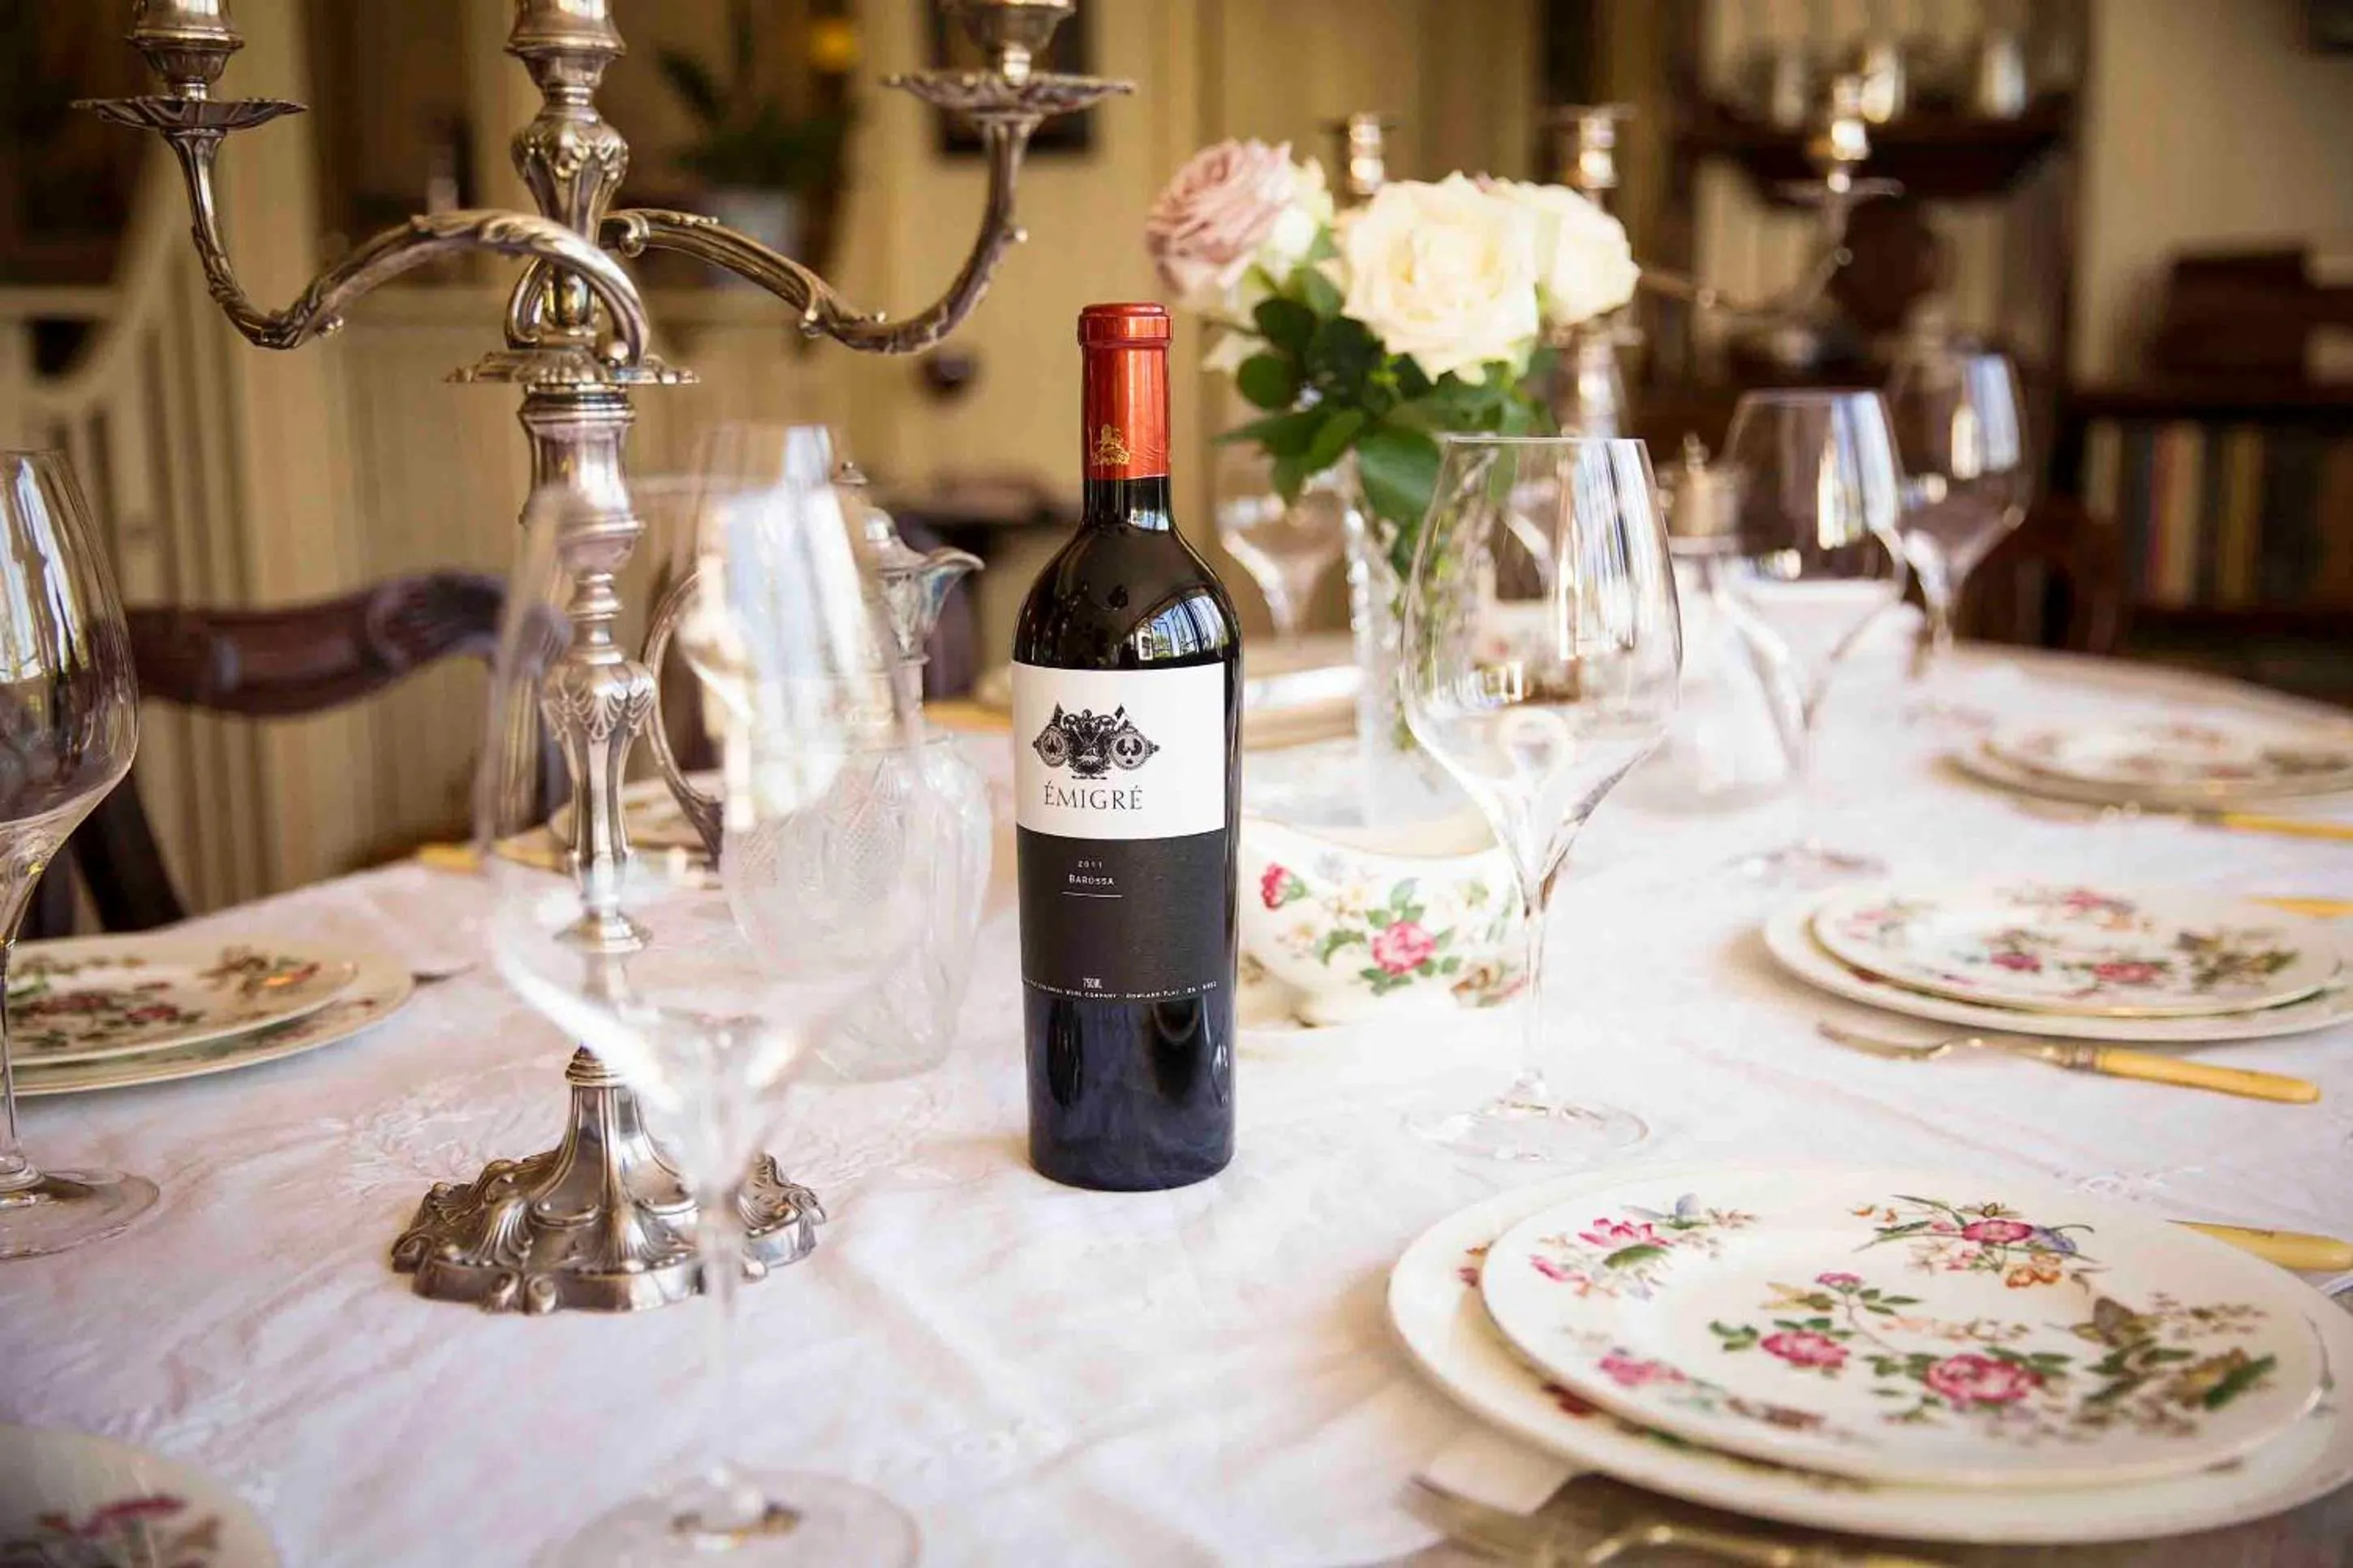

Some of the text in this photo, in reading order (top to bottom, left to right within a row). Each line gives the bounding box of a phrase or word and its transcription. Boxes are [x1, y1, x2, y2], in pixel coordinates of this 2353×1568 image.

[1043, 780, 1143, 810] ÉMIGRÉ
[1077, 860, 1103, 869] 2011
[1069, 874, 1115, 886] BAROSSA
